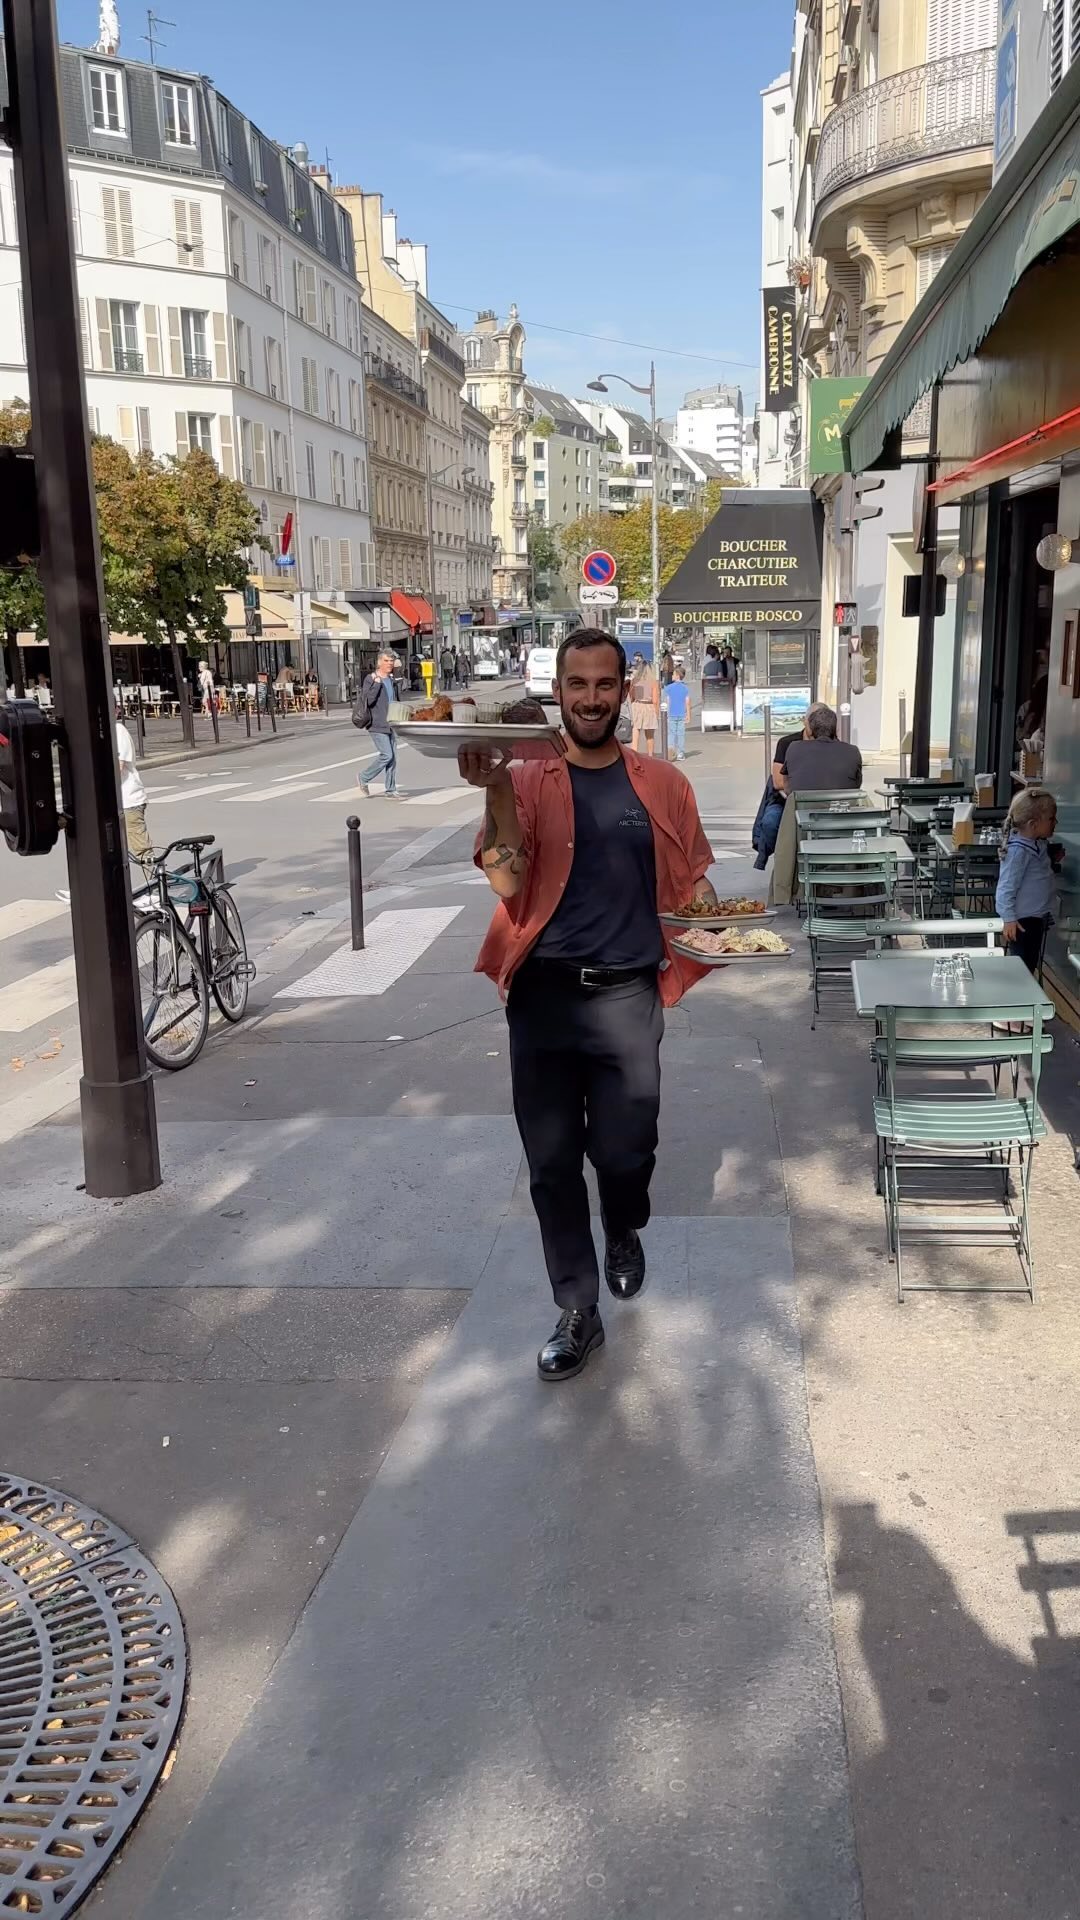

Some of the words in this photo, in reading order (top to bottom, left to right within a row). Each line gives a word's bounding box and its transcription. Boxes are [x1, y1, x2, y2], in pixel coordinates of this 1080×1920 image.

[768, 305, 780, 395] CAMBRONNE
[781, 312, 793, 388] CARLADEZ
[720, 540, 787, 553] BOUCHER
[708, 556, 799, 571] CHARCUTIER
[718, 575, 788, 587] TRAITEUR
[673, 611, 753, 624] BOUCHERIE
[755, 610, 803, 622] BOSCO
